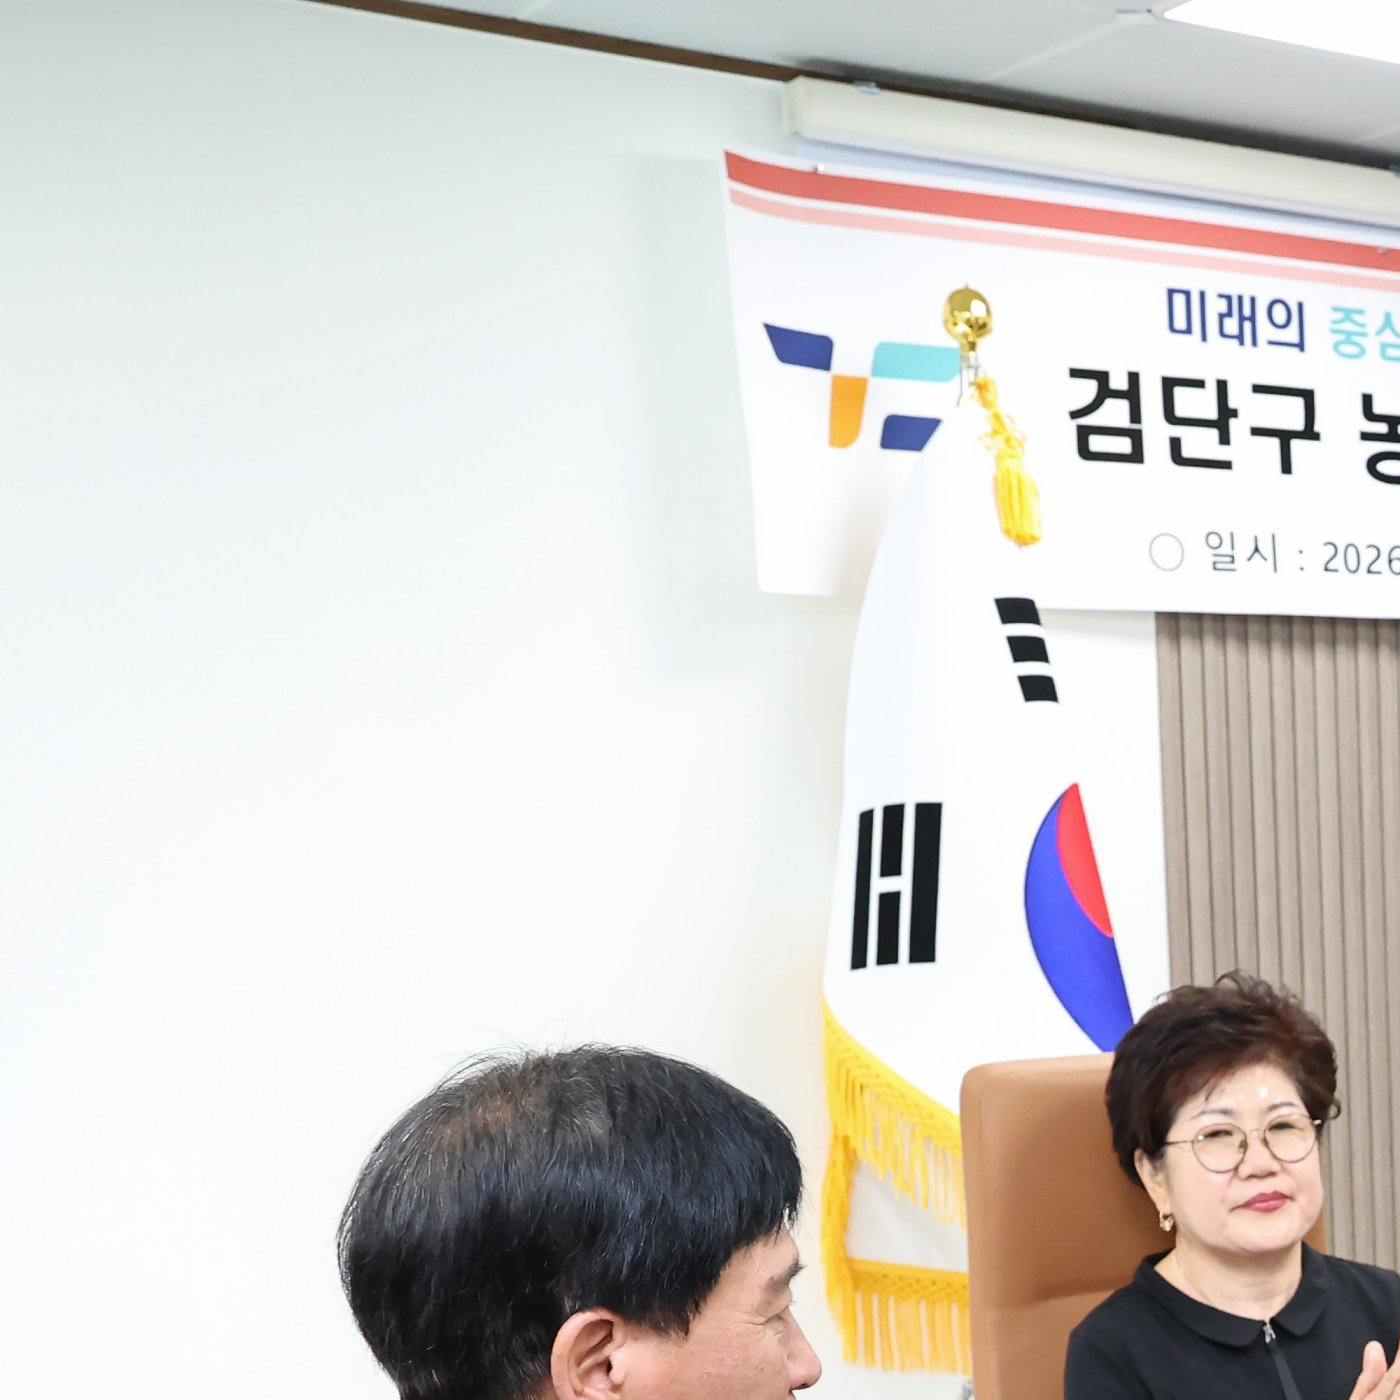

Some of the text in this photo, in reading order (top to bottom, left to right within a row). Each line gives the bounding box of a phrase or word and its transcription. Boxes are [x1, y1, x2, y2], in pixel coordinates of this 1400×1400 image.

[1166, 287, 1306, 353] 미래의
[1067, 367, 1321, 475] 검단구
[1205, 531, 1278, 574] 일시
